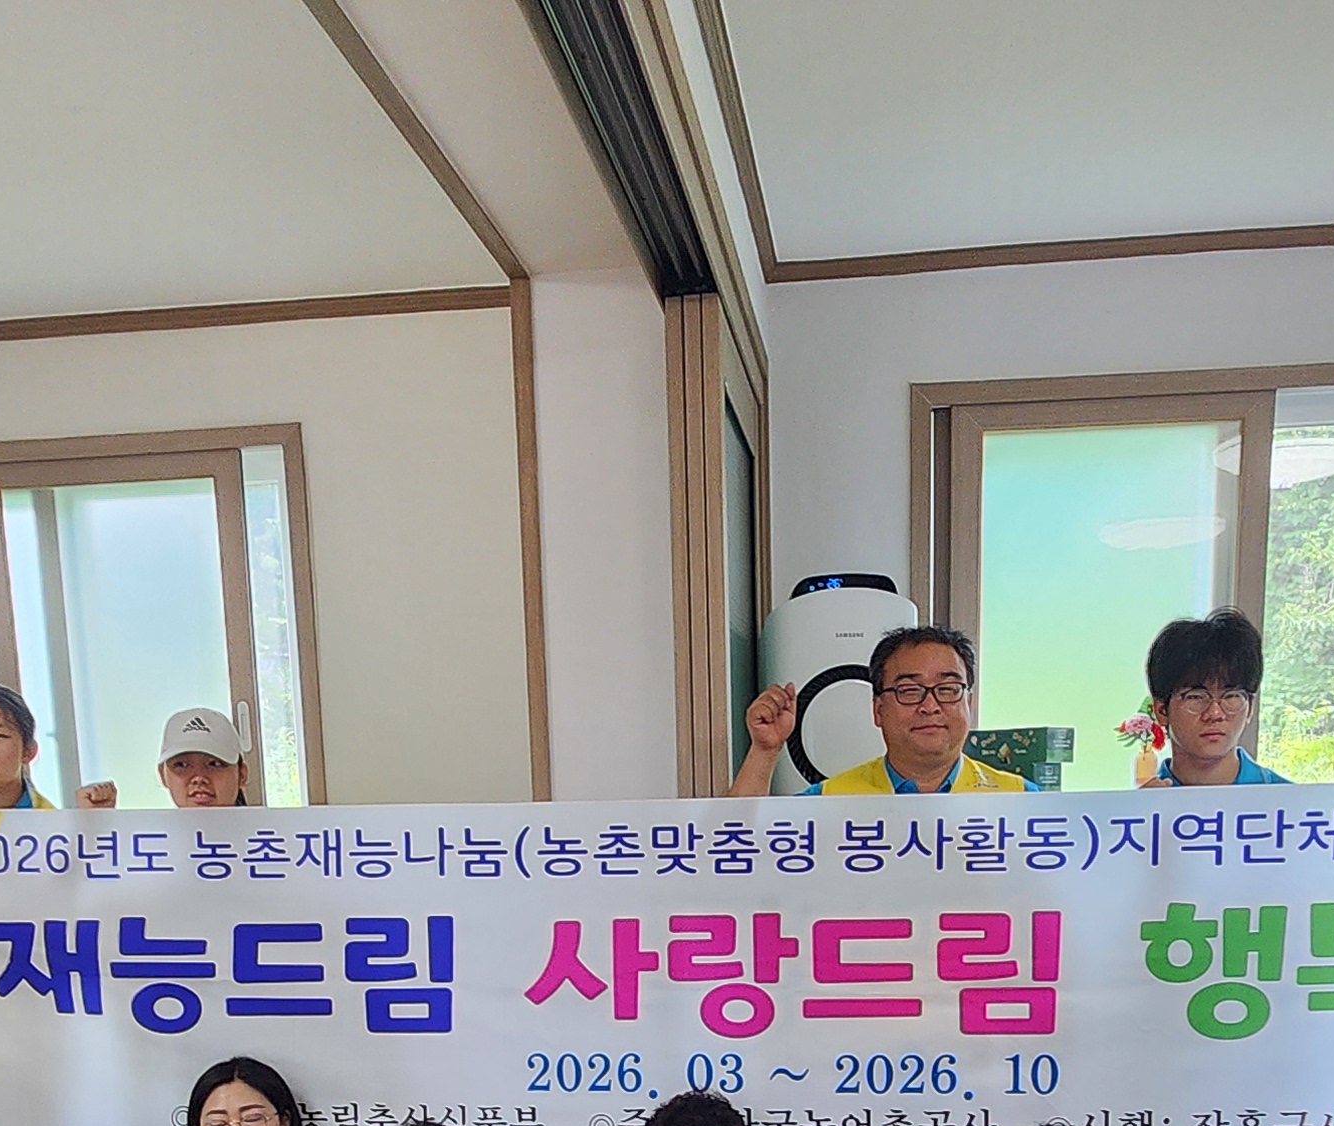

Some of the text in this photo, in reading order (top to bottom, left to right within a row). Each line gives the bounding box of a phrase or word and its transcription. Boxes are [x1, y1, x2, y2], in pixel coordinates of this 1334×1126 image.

[188, 822, 817, 882] 농촌재능나눔(농촌맞춤형
[522, 909, 1064, 1040] 사랑드림
[526, 1051, 660, 1099] 2026.
[686, 1052, 746, 1094] 03
[834, 1053, 975, 1102] 2026.
[1003, 1052, 1060, 1095] 10
